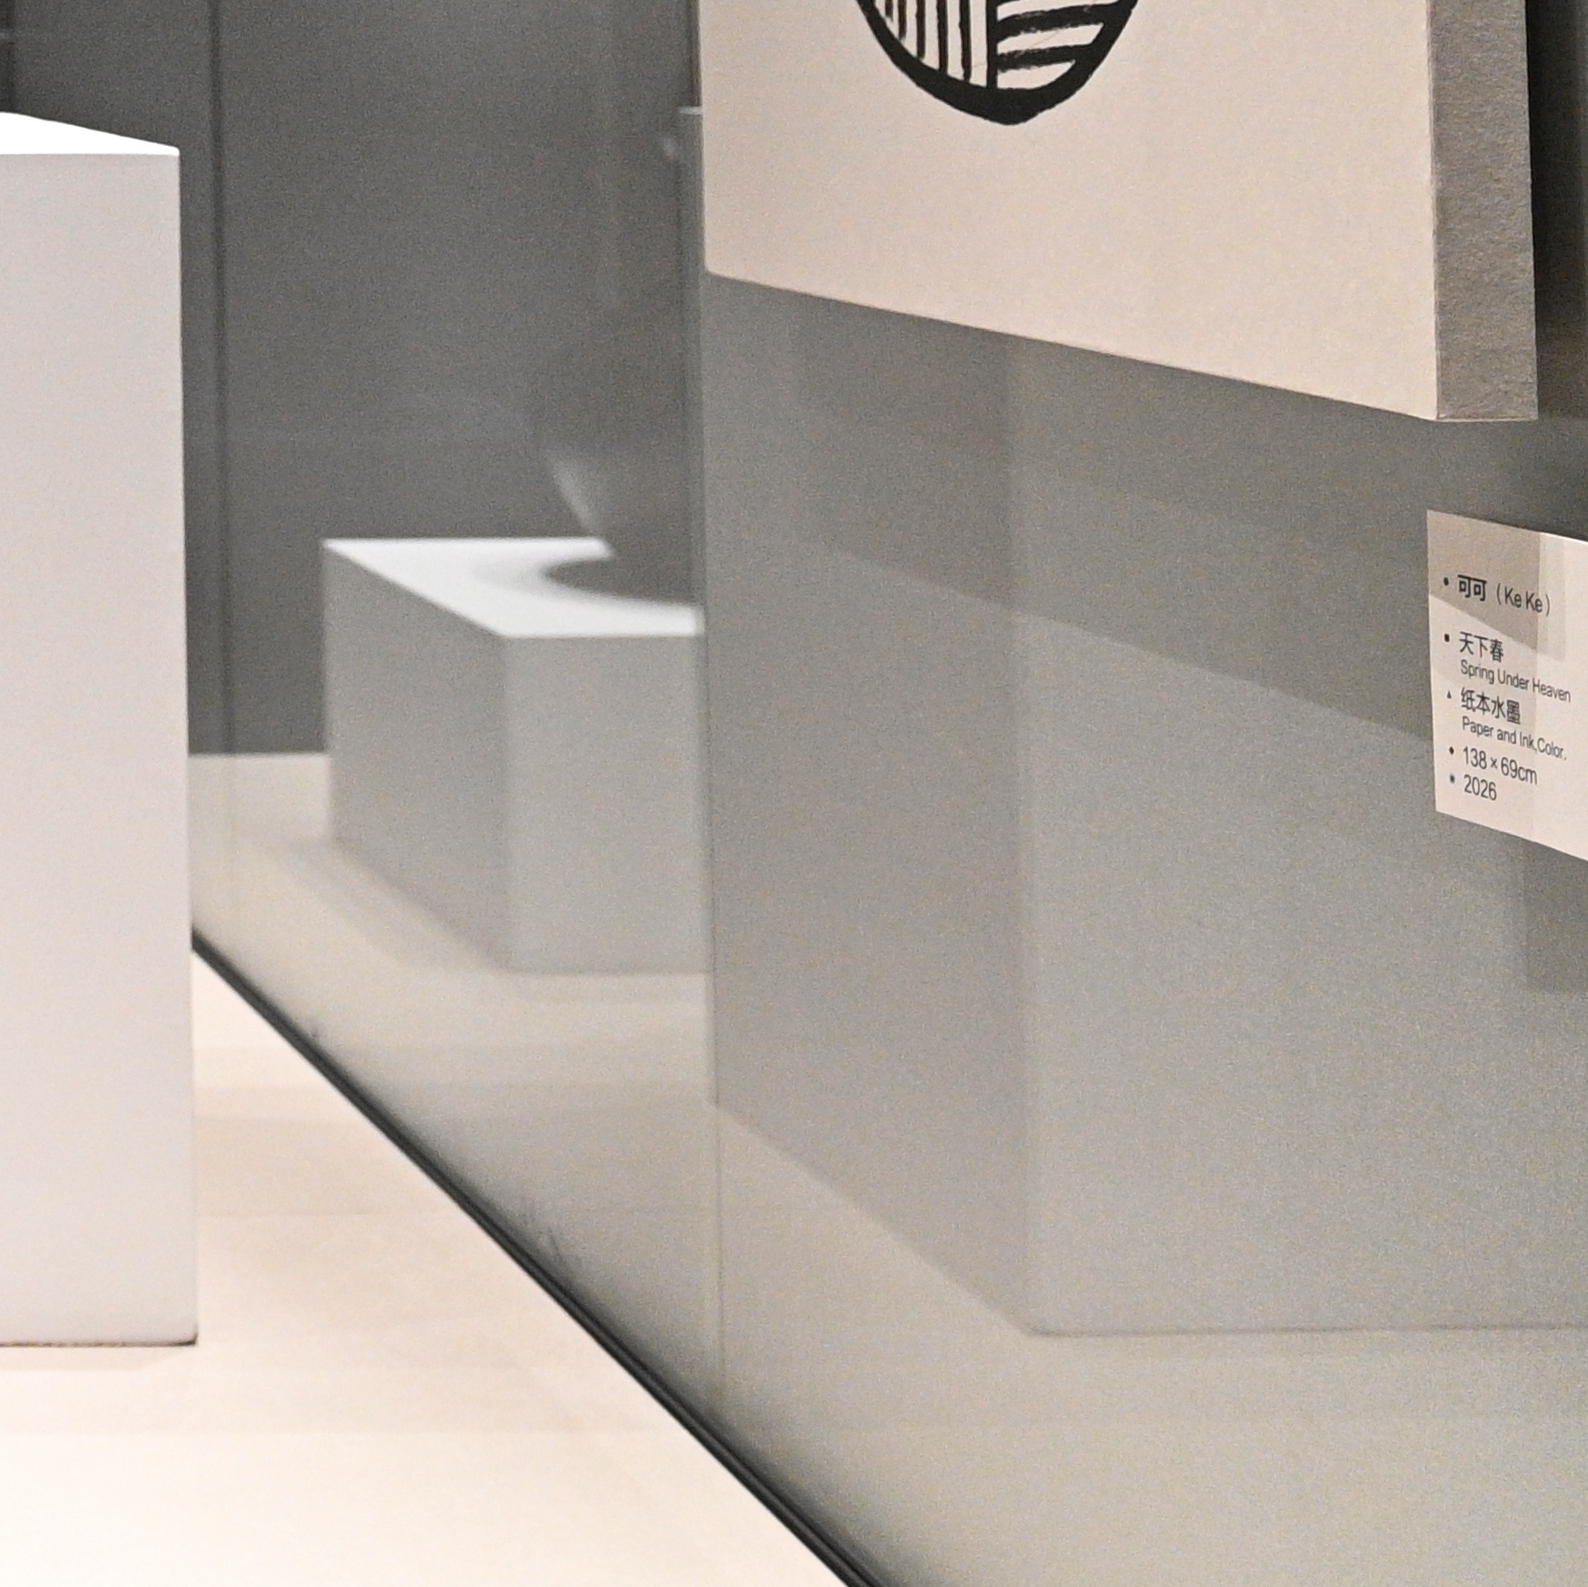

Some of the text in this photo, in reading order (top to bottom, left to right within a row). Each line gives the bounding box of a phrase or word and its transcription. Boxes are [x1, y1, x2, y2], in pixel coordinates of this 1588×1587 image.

[1457, 574, 1487, 601] 可可
[1459, 631, 1504, 662] 天下春
[1461, 659, 1571, 703] Spring Under Heaven
[1461, 687, 1521, 724] 纸本水墨
[1462, 716, 1494, 737] Paper
[1497, 728, 1516, 745] and
[1464, 774, 1497, 801] 2026
